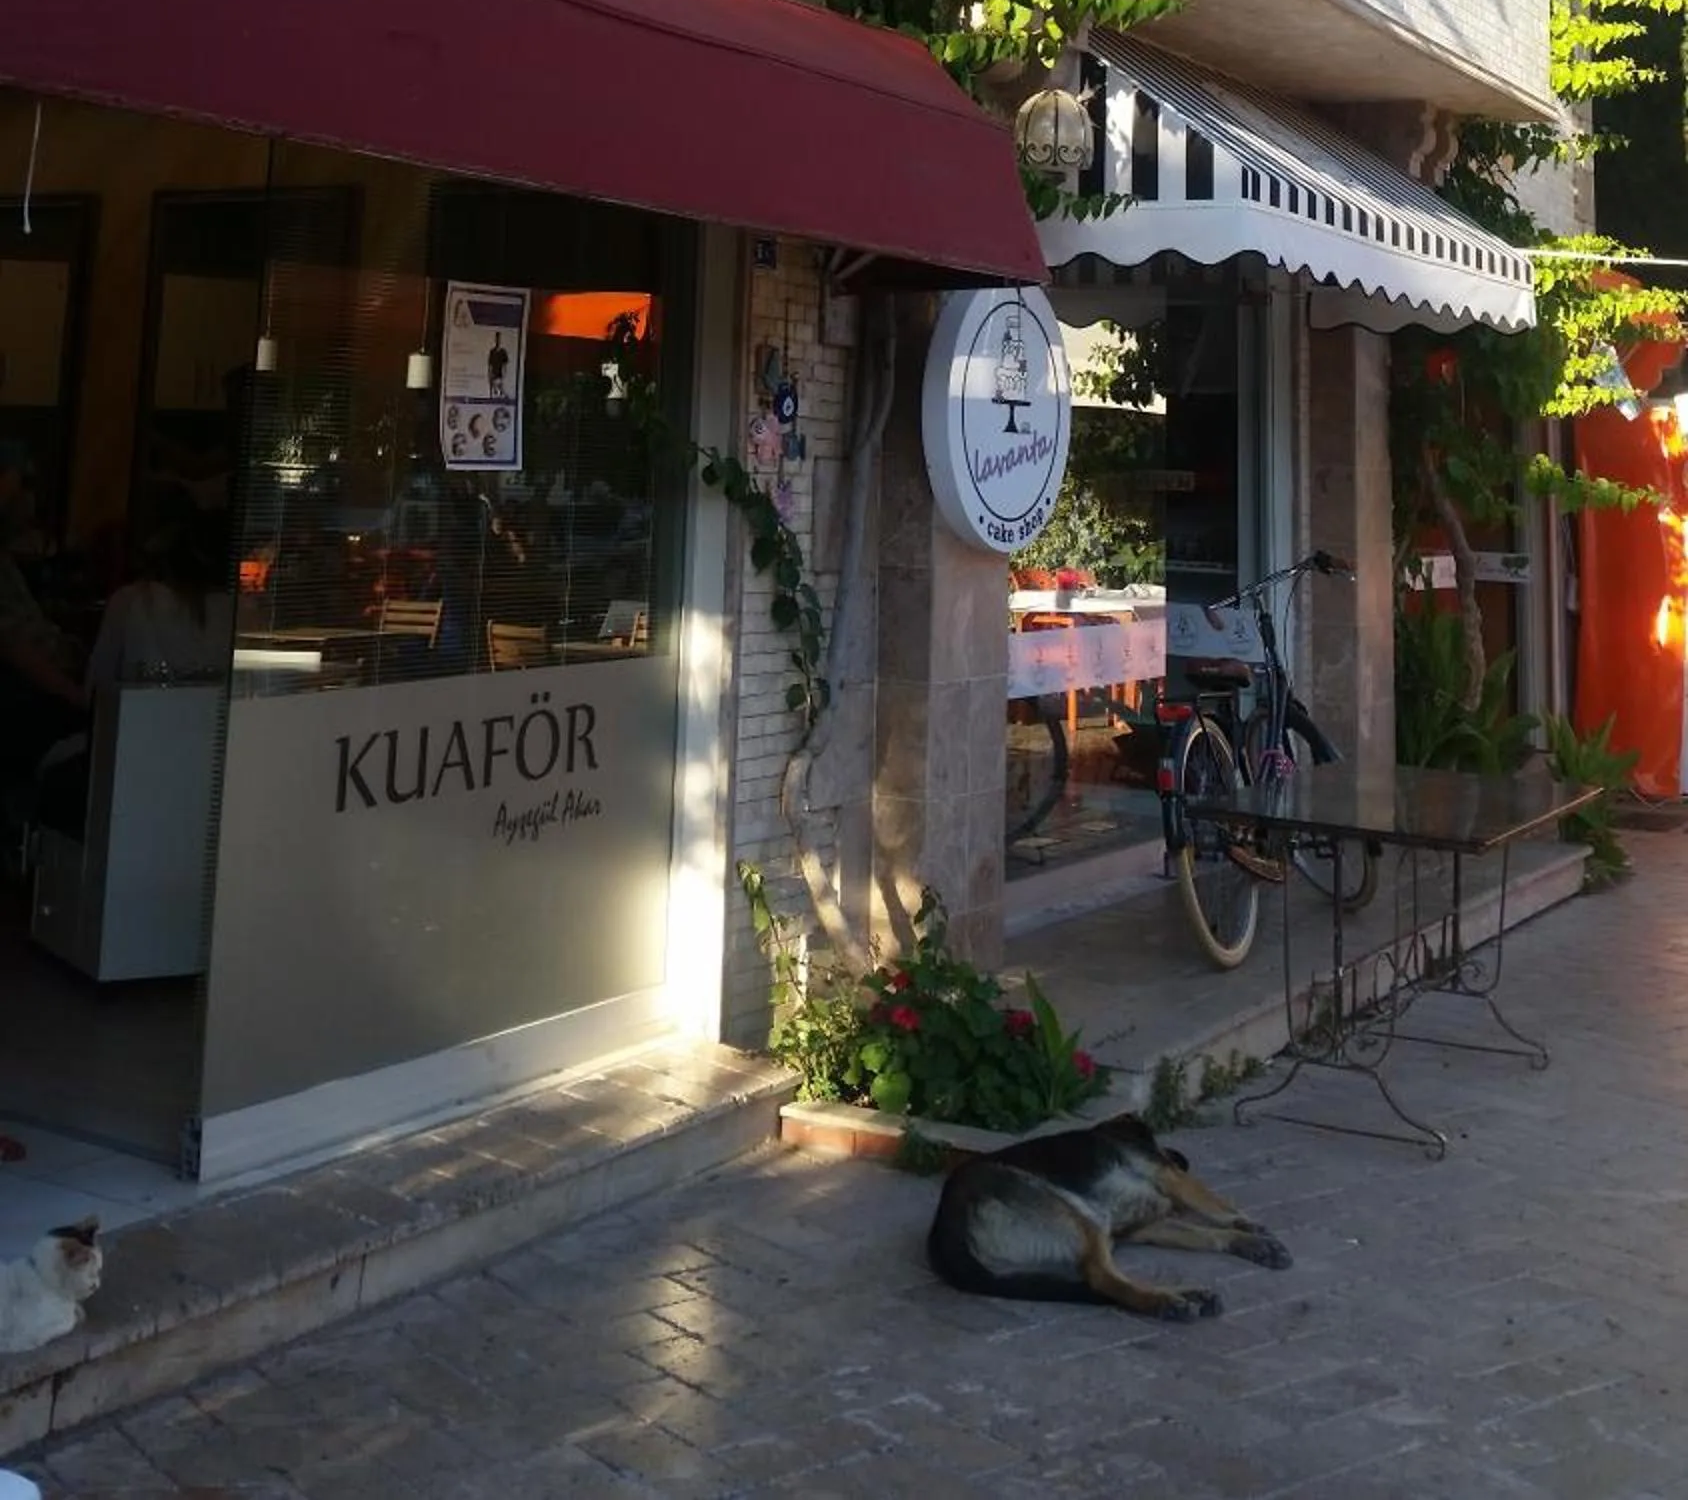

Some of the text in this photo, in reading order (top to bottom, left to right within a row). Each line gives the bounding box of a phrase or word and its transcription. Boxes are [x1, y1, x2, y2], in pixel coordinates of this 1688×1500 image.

[975, 430, 1053, 483] lavanta
[987, 507, 1044, 543] cake shop
[335, 691, 599, 812] KUAFÖR
